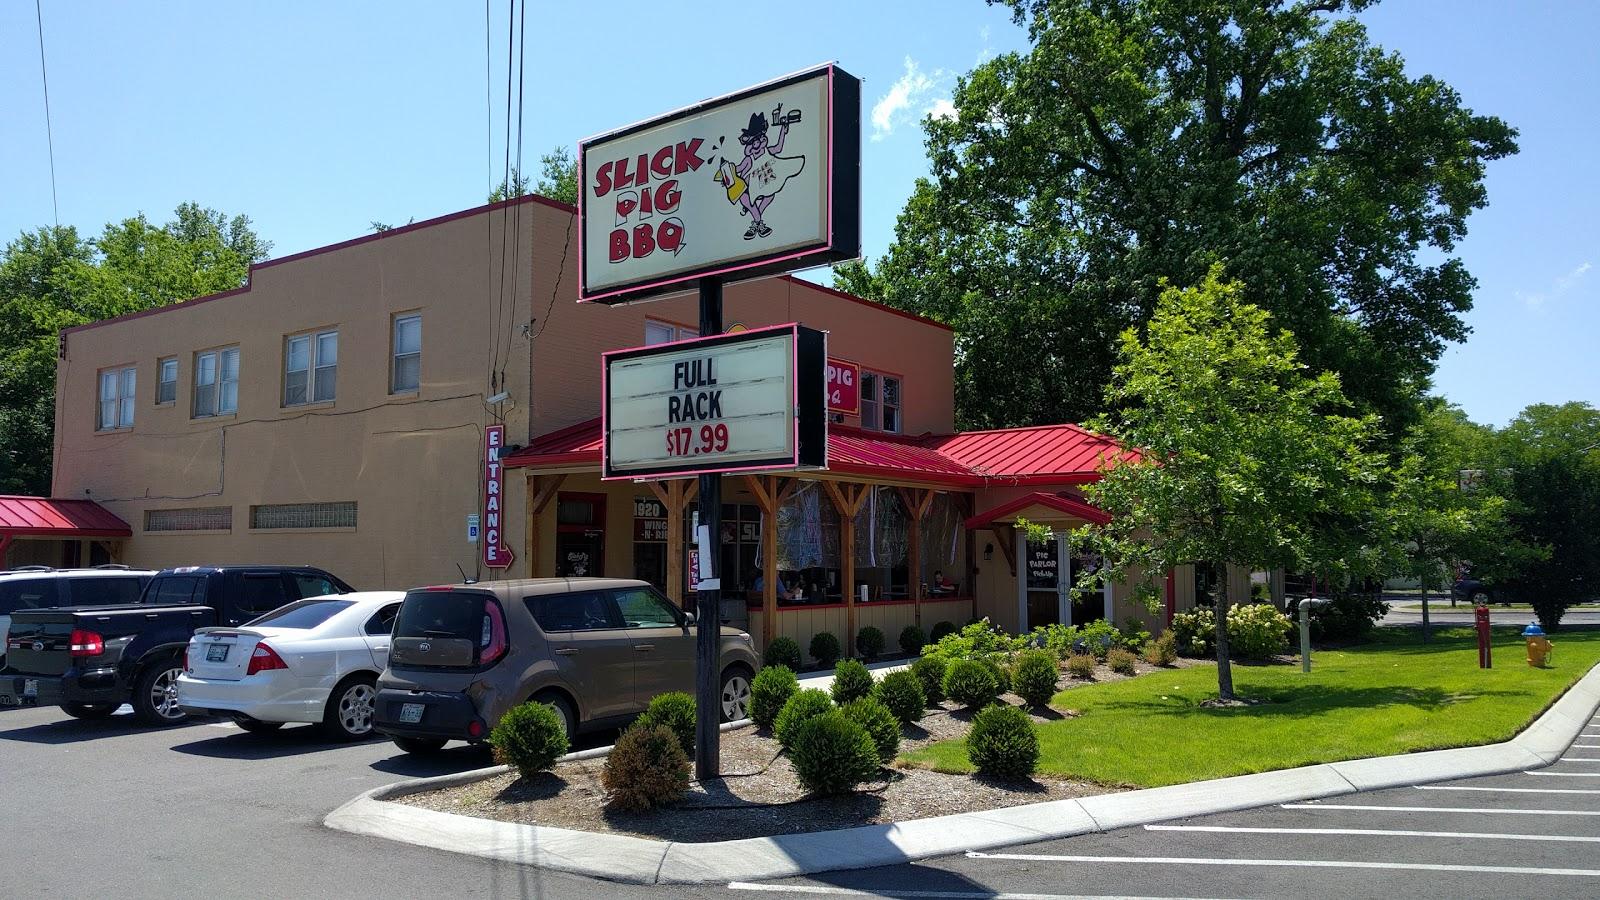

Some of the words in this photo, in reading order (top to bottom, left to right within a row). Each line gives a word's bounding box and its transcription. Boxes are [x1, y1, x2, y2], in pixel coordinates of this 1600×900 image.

[593, 138, 704, 197] SLICK
[615, 180, 682, 227] PIG
[609, 217, 686, 263] BBQ
[674, 358, 717, 389] FULL
[828, 366, 852, 386] PIG
[668, 390, 722, 423] RACK
[666, 423, 729, 456] $17.99
[487, 431, 499, 560] ENTRANCE
[633, 502, 660, 517] 1920
[644, 520, 668, 530] WING
[1029, 560, 1057, 568] PARLOR
